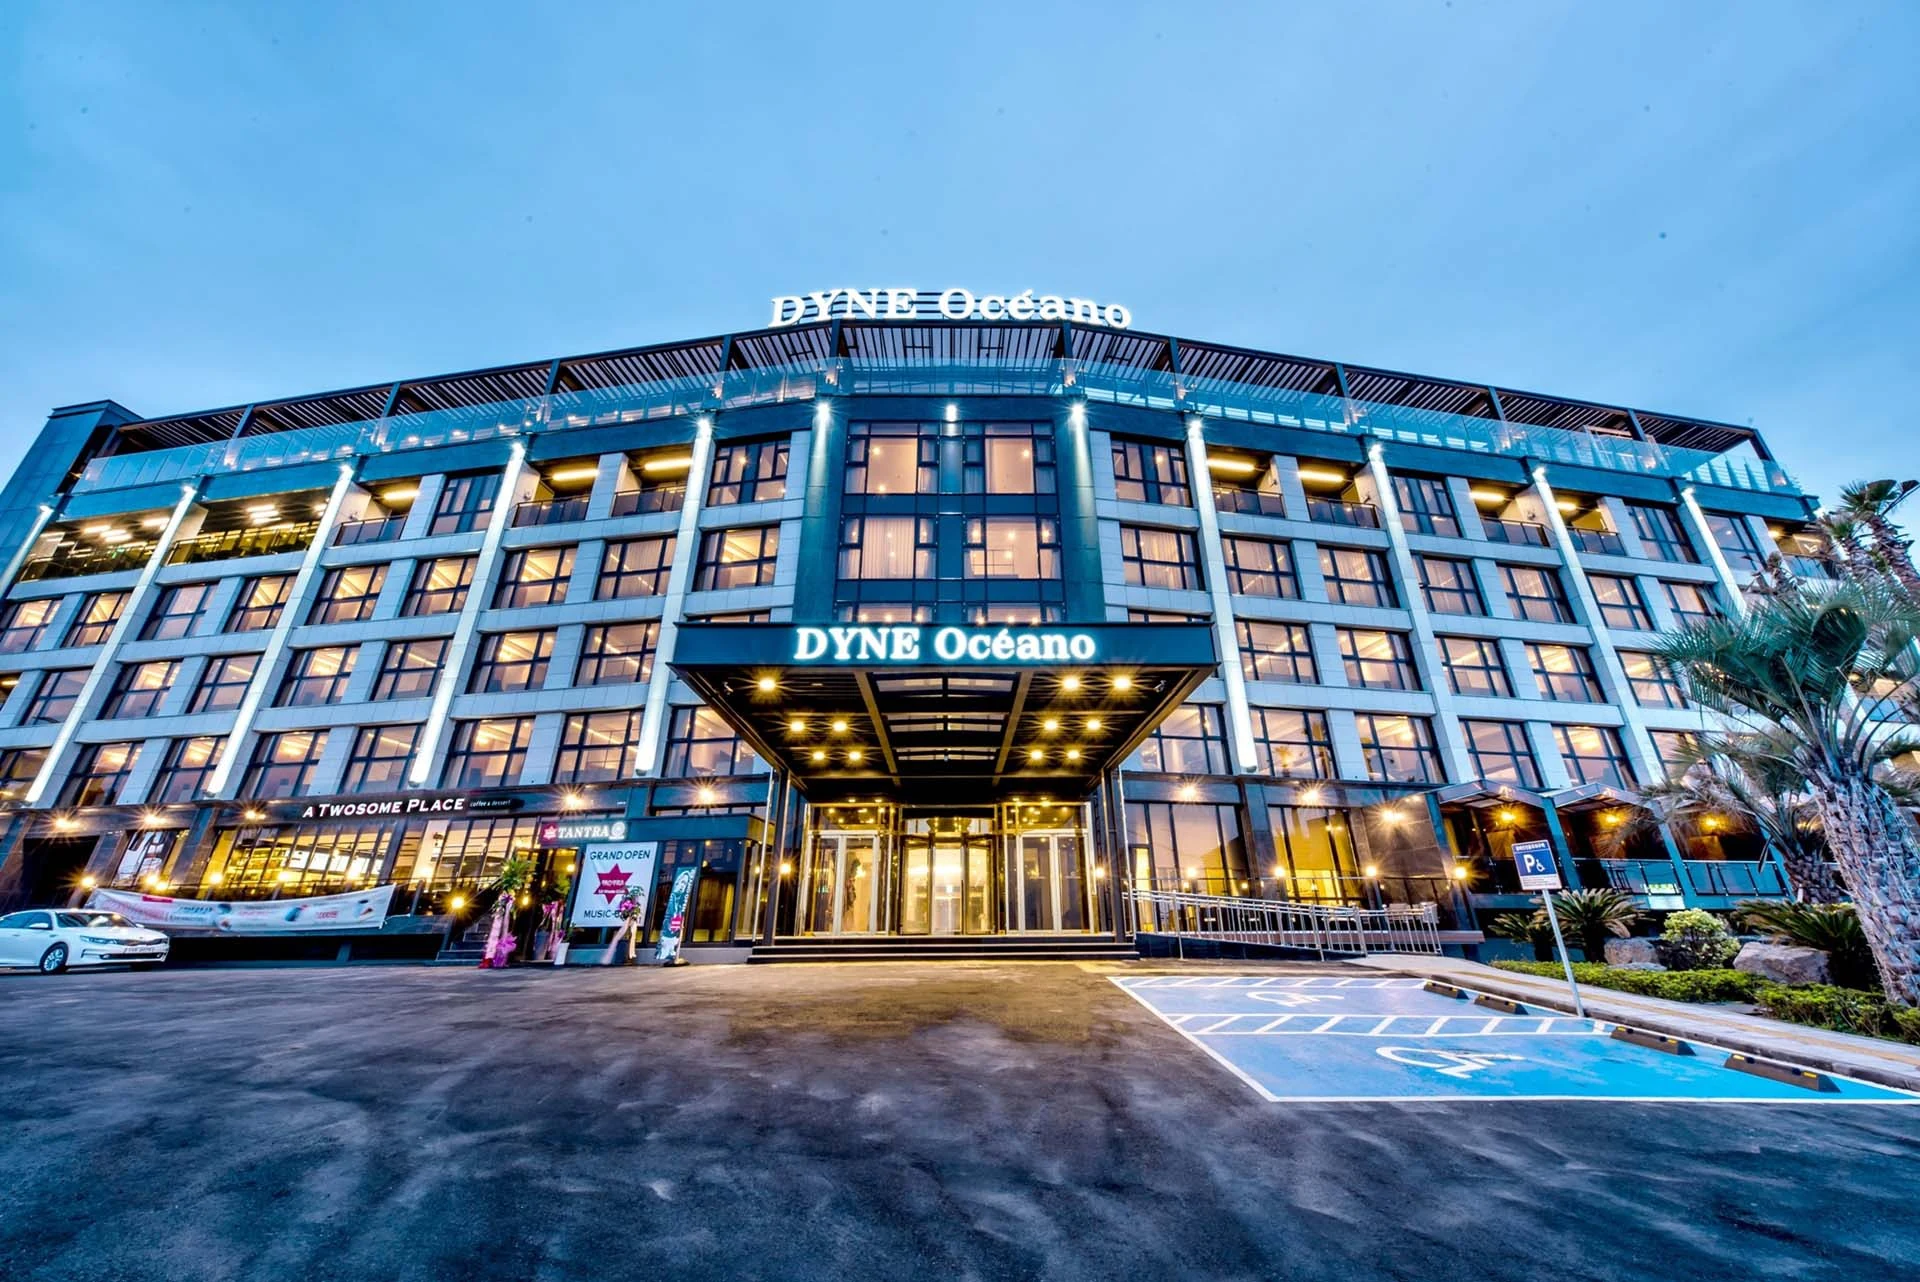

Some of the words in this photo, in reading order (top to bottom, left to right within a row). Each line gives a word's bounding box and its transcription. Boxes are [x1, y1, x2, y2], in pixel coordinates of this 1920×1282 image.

[769, 288, 918, 328] DYNE
[938, 287, 1132, 330] Océano
[793, 627, 921, 661] DYNE
[934, 626, 1096, 661] Océano
[302, 806, 314, 818] A
[319, 801, 402, 818] TWOSOME
[406, 798, 465, 813] PLACE
[558, 825, 609, 839] TANTRA
[589, 851, 623, 861] GRAND
[624, 849, 651, 860] OPEN
[1523, 854, 1535, 873] P
